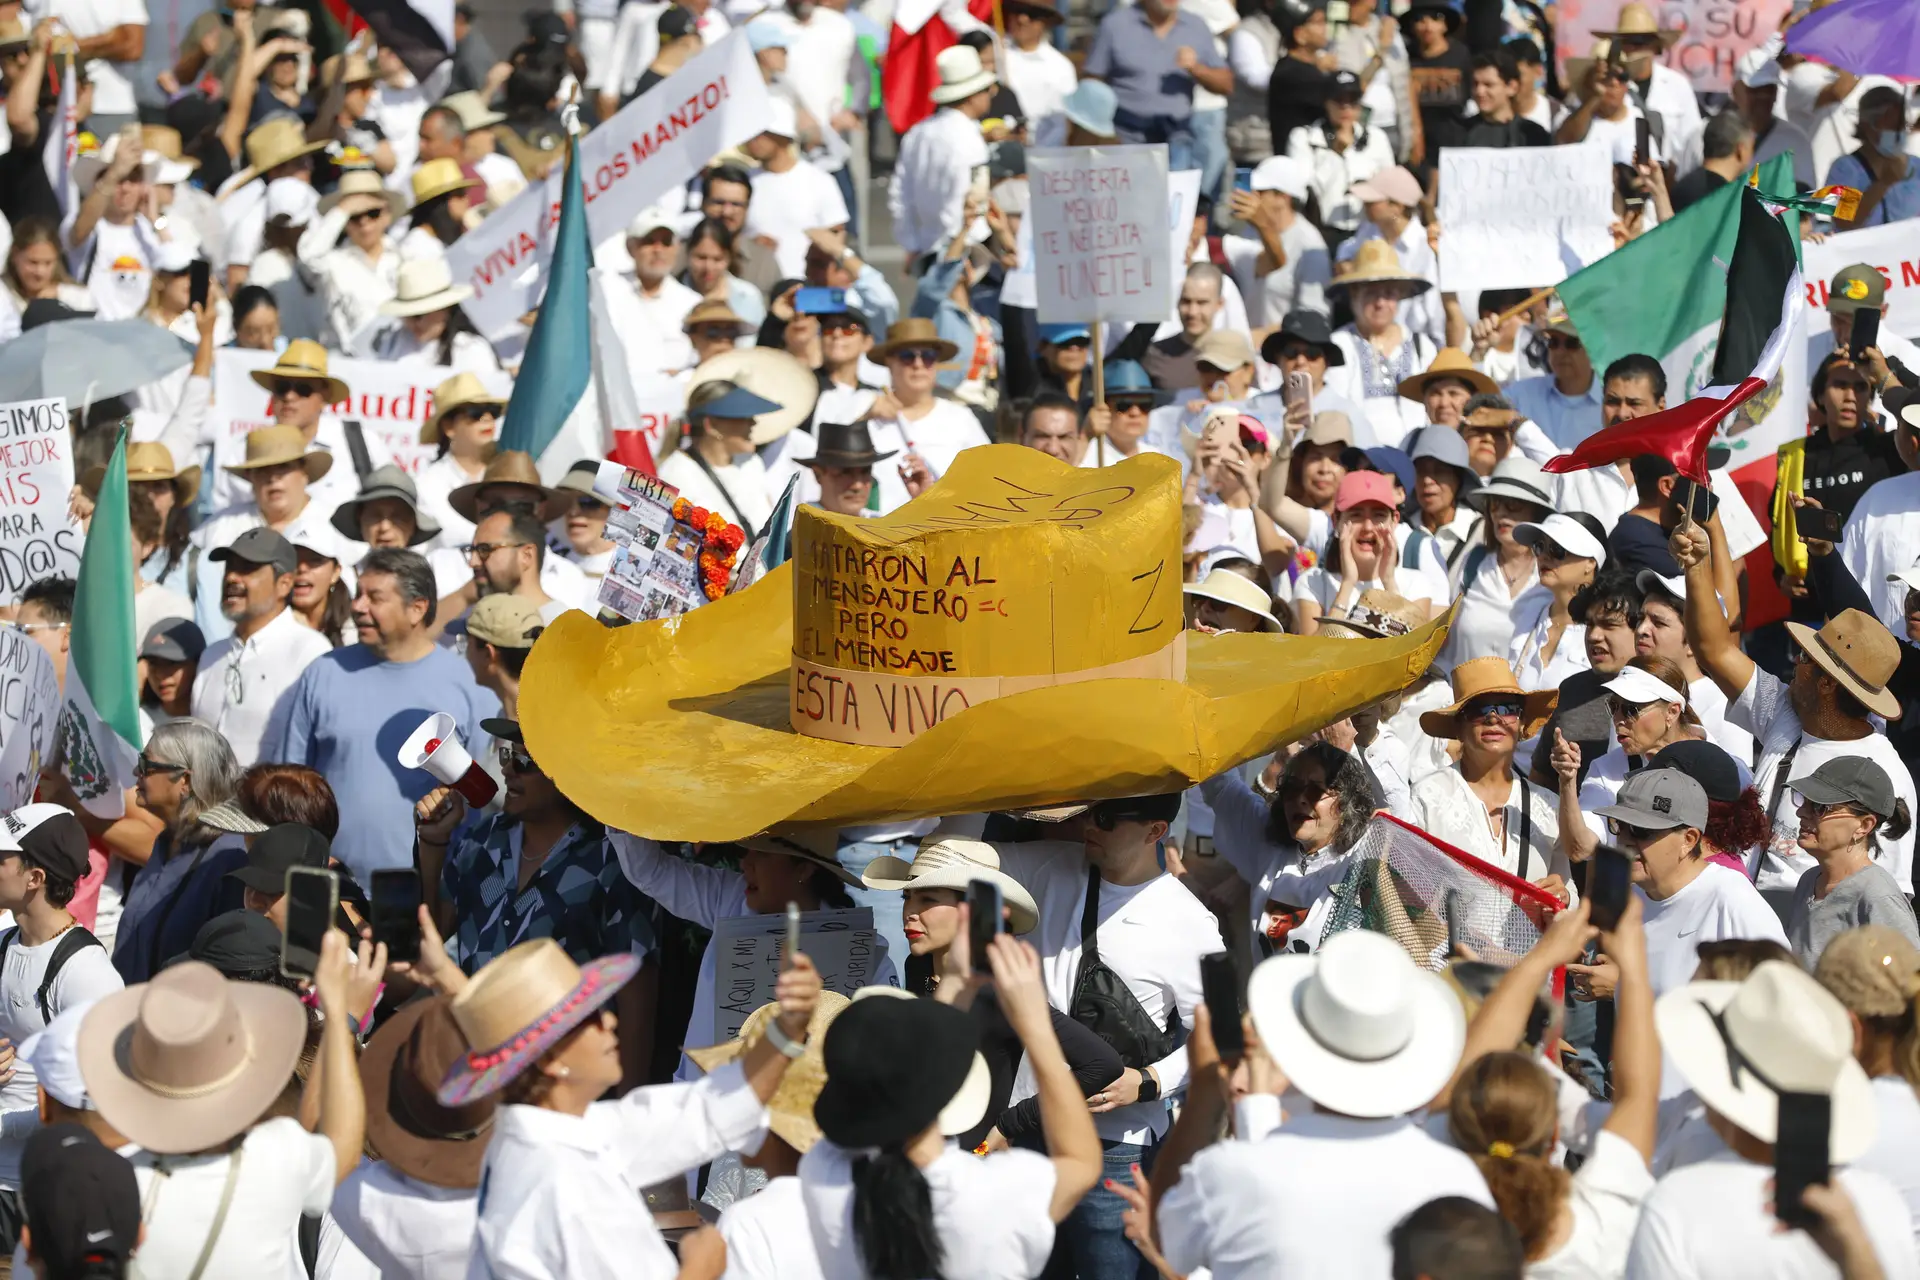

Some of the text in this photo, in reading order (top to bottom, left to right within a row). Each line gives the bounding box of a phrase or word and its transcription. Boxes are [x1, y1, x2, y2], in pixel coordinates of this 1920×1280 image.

[1706, 8, 1756, 39] SU
[537, 152, 632, 236] CALOS
[630, 74, 732, 167] MANZO!
[944, 556, 997, 587] AL
[813, 574, 969, 623] MENSAJERO
[839, 608, 909, 642] PERO
[802, 627, 957, 674] EL MENSAJE
[796, 667, 860, 731] ESTA
[736, 937, 758, 957] MIS
[731, 960, 755, 970] X
